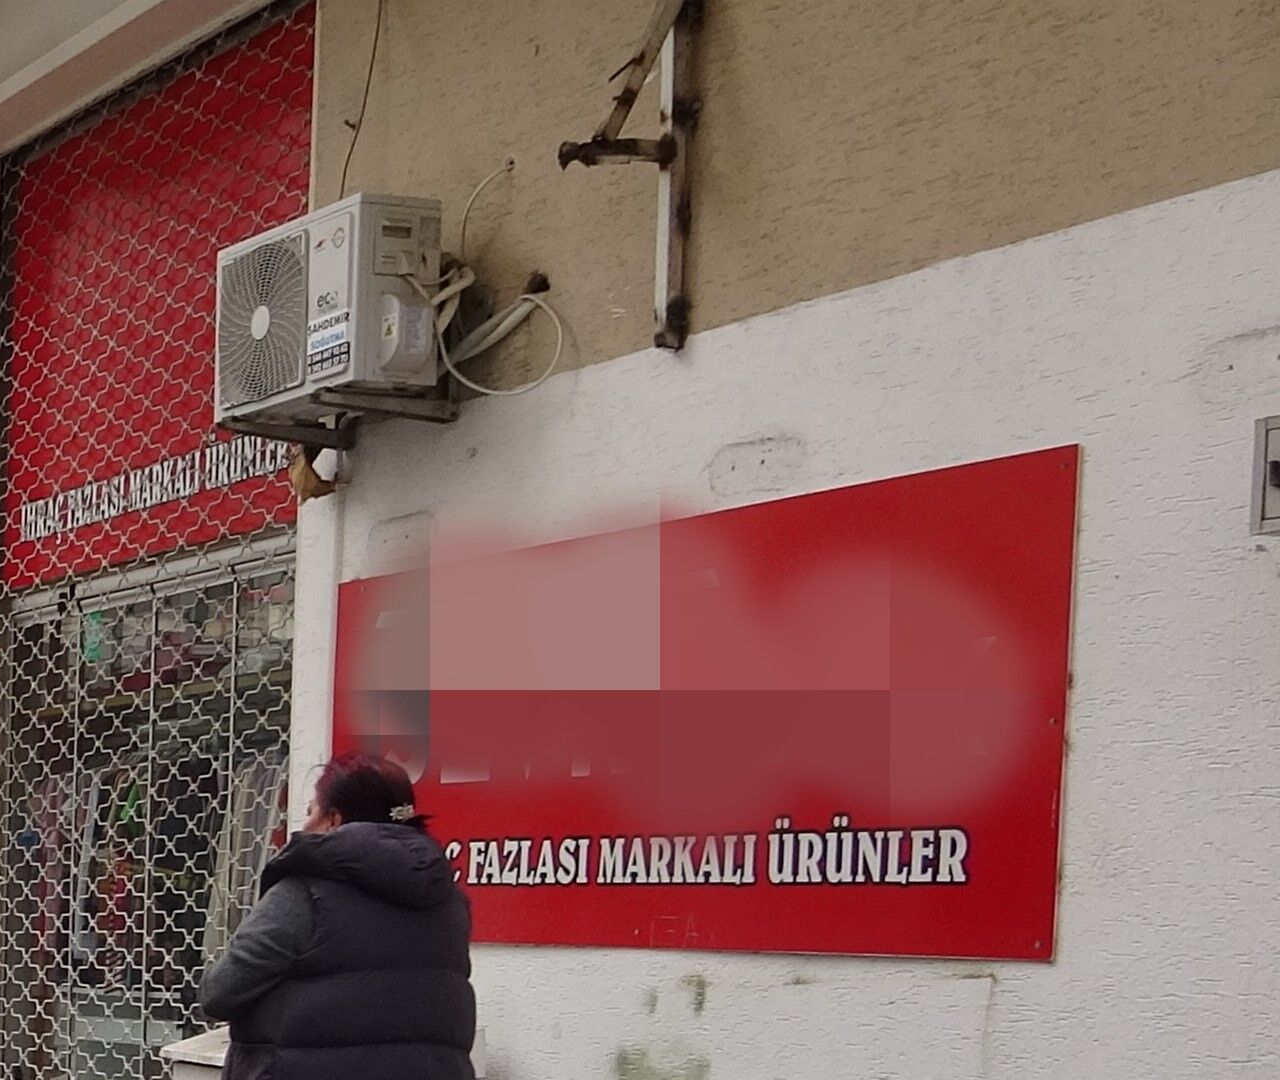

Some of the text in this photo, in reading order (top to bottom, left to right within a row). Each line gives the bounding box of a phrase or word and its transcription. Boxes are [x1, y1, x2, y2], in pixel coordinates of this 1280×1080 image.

[467, 837, 590, 886] FAZLASI
[596, 833, 757, 886] MARKALI
[768, 816, 968, 885] ÜRÜNLER
